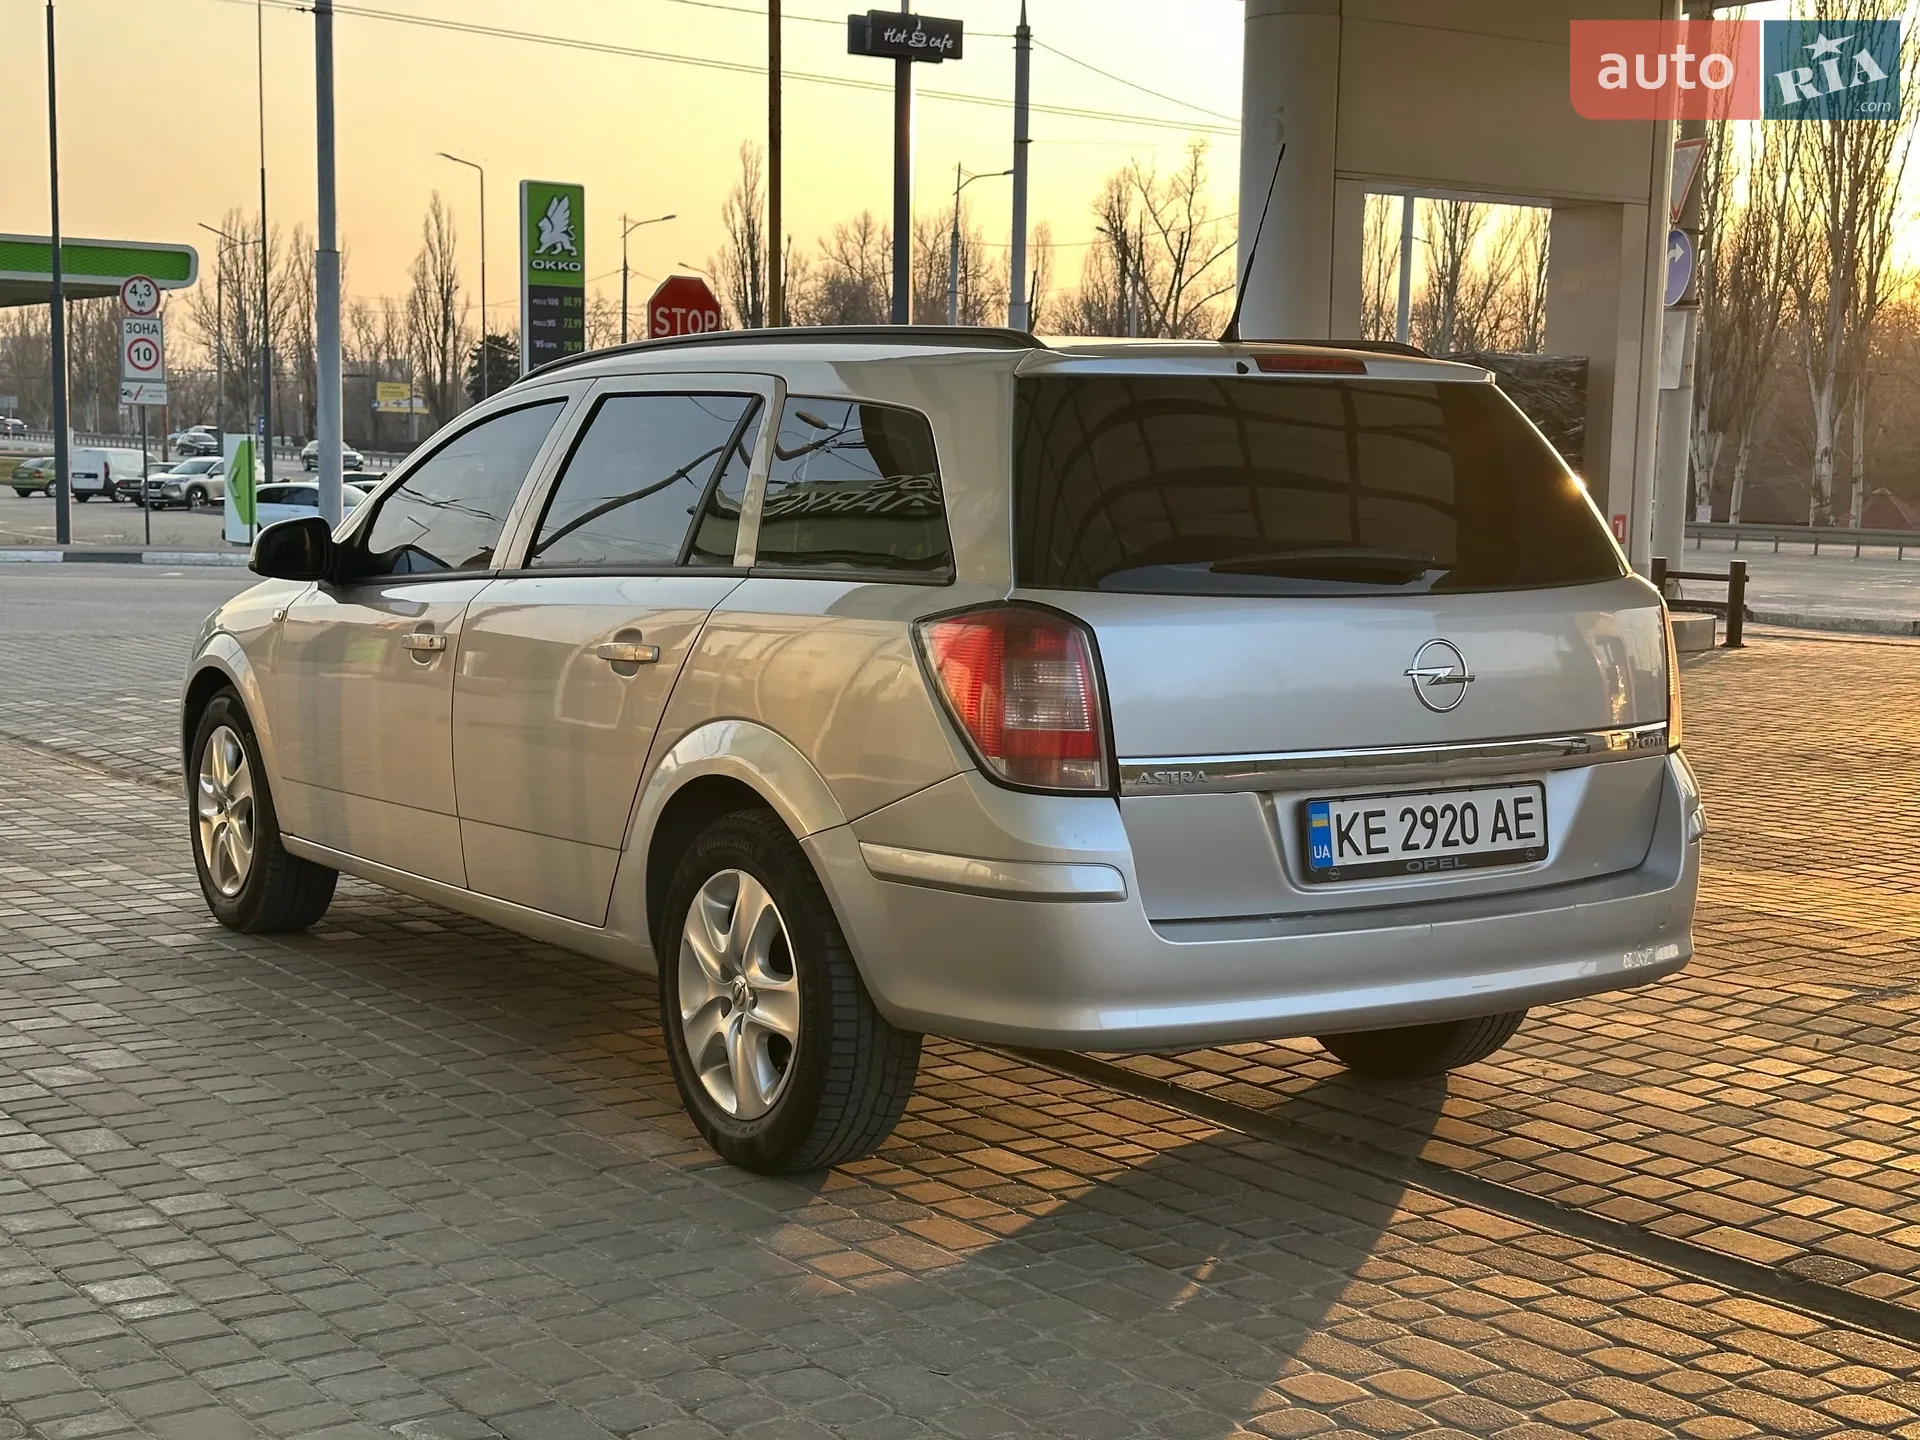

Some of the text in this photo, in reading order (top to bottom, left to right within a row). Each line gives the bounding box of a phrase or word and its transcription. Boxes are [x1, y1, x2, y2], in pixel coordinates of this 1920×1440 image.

[884, 28, 953, 53] Hot cafe
[532, 260, 581, 271] OKKO
[129, 284, 152, 299] 4,3
[654, 306, 717, 335] STOP
[126, 323, 159, 335] ЗОНА
[134, 348, 152, 361] 10
[1135, 771, 1208, 785] ASTRA
[1335, 795, 1536, 857] KE 2920 AE
[1313, 845, 1330, 859] UA
[1405, 857, 1467, 872] OPEL
